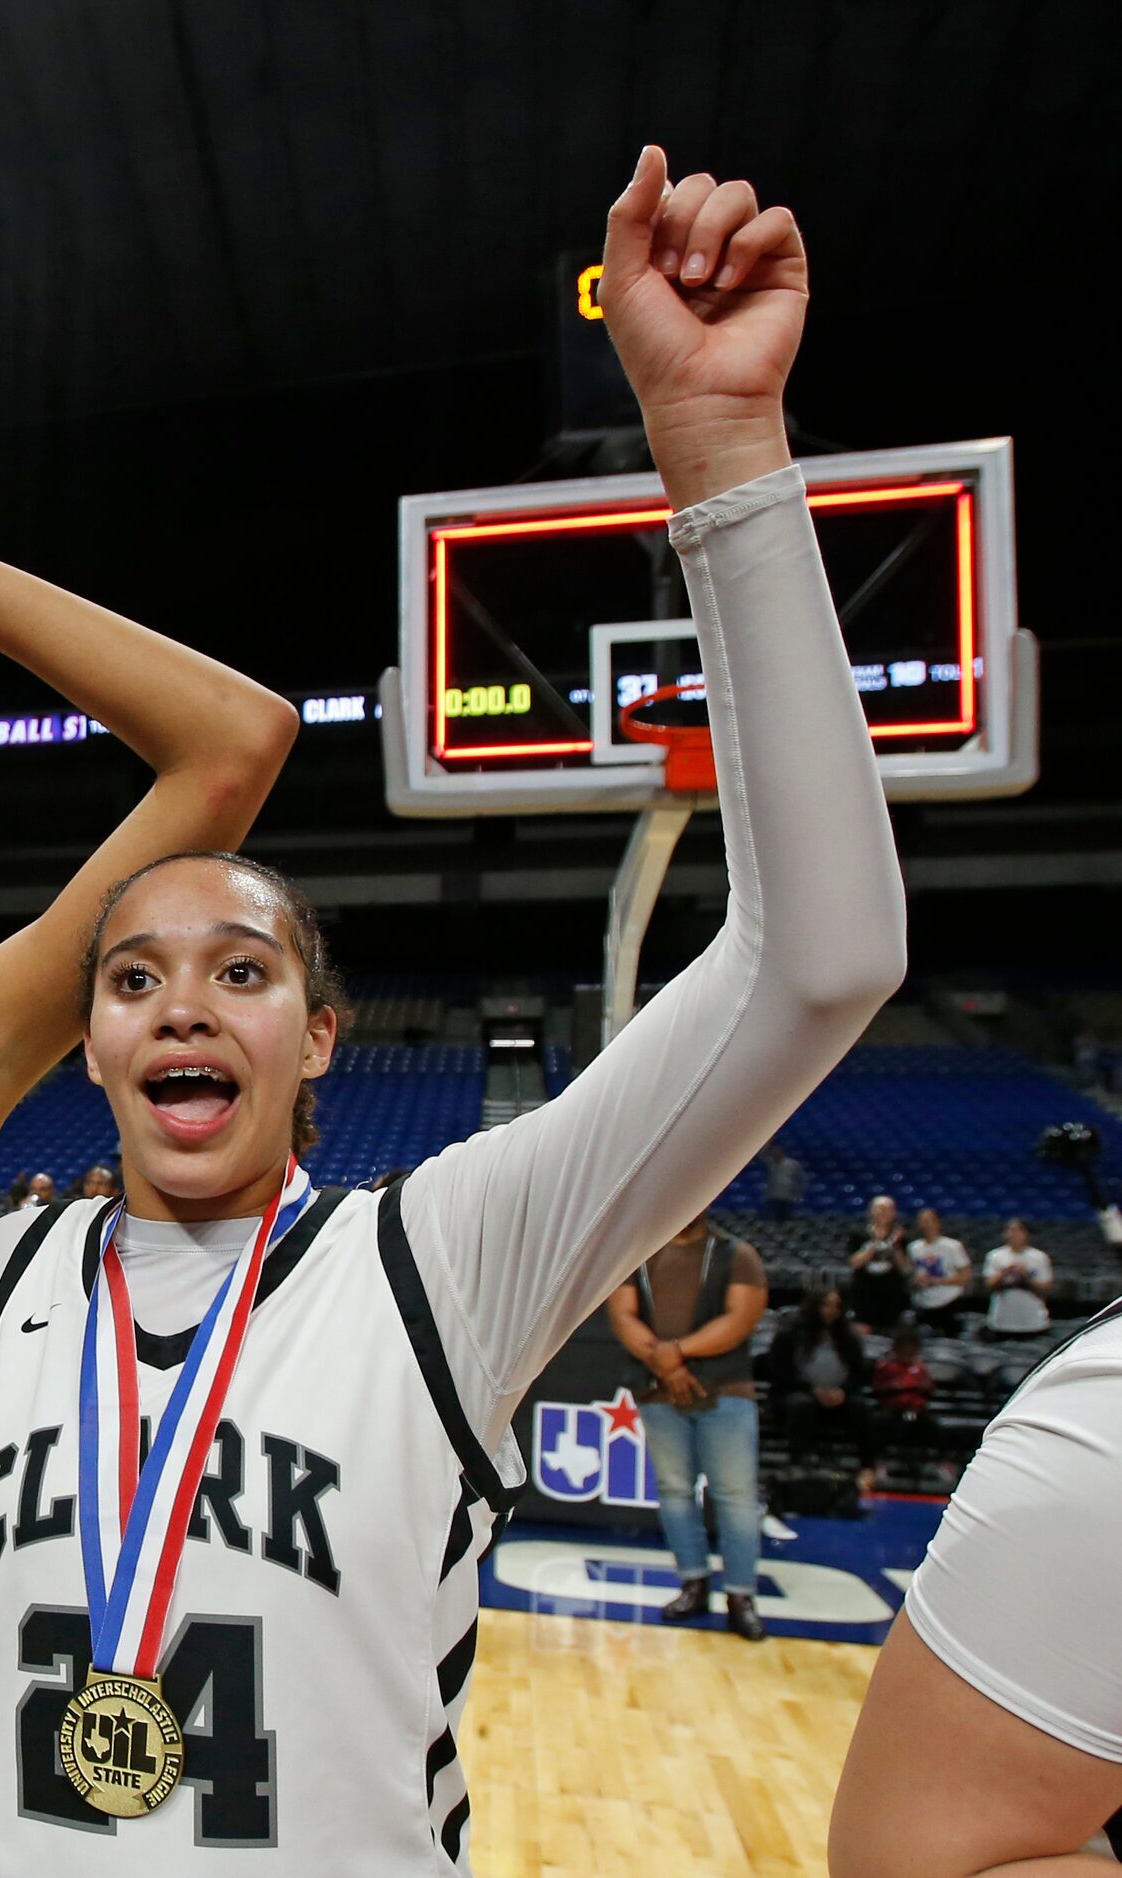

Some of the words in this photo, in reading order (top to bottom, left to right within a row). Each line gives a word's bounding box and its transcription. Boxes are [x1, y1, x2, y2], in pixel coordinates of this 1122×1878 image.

[303, 696, 365, 723] CLARK
[445, 684, 531, 717] 0:00.0
[532, 1392, 660, 1508] UI
[15, 1602, 279, 1848] 24
[60, 1711, 91, 1795] UNIVERSITY
[78, 1682, 178, 1744] INTERSCHOLASTIC
[146, 1755, 181, 1808] LEAGUE
[81, 1709, 156, 1774] UIL
[93, 1767, 141, 1789] STATE
